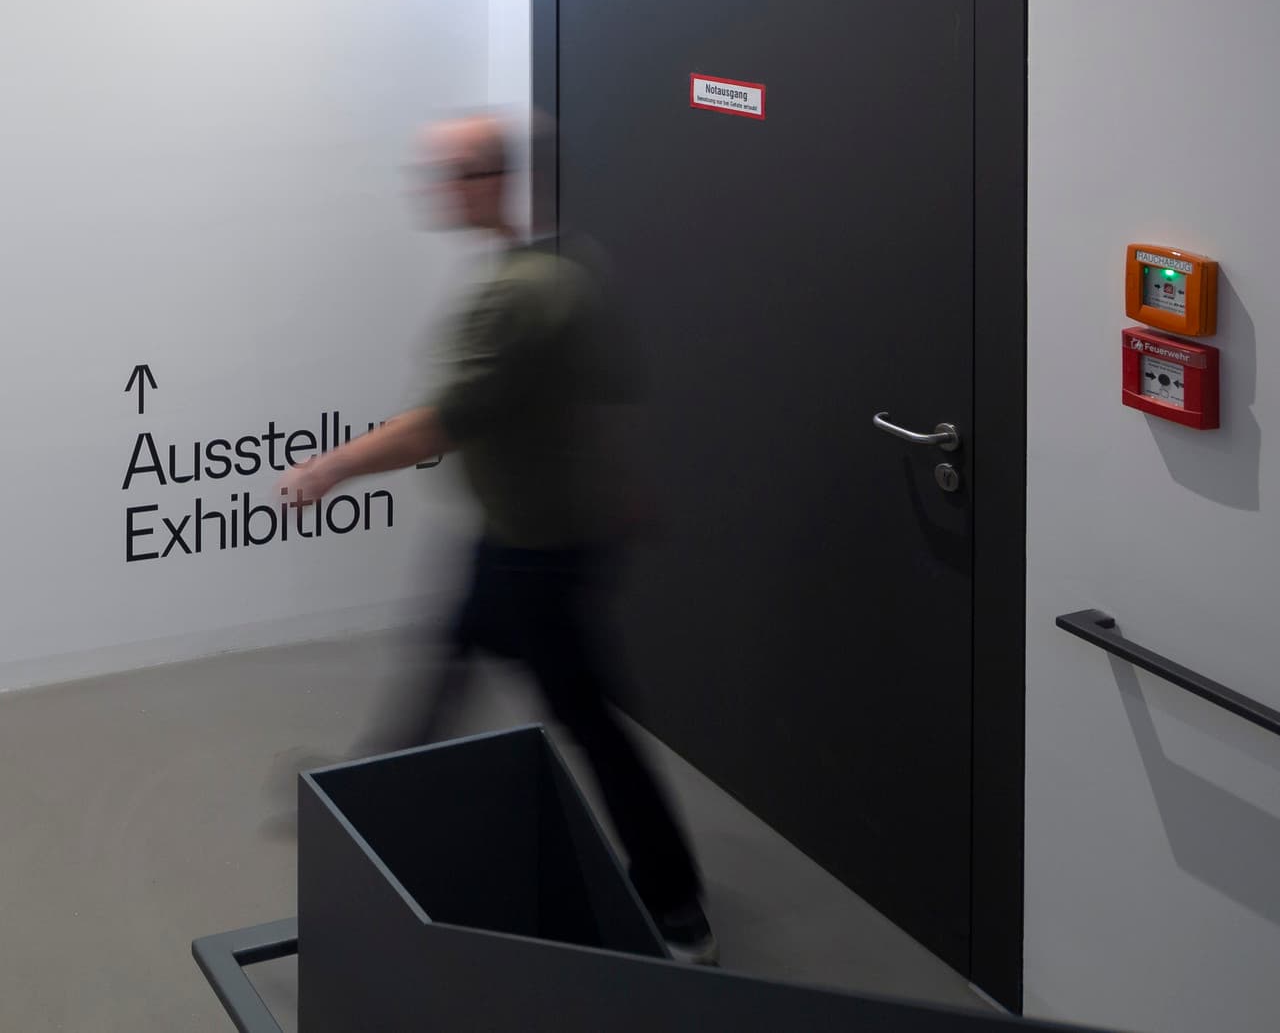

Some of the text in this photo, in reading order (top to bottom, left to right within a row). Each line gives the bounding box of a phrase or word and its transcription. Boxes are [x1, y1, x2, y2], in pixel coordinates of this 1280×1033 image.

[705, 83, 748, 102] Notausgang
[1144, 343, 1190, 362] Feuerwehr
[122, 411, 444, 490] Ausstell
[126, 488, 394, 562] Exhibition
